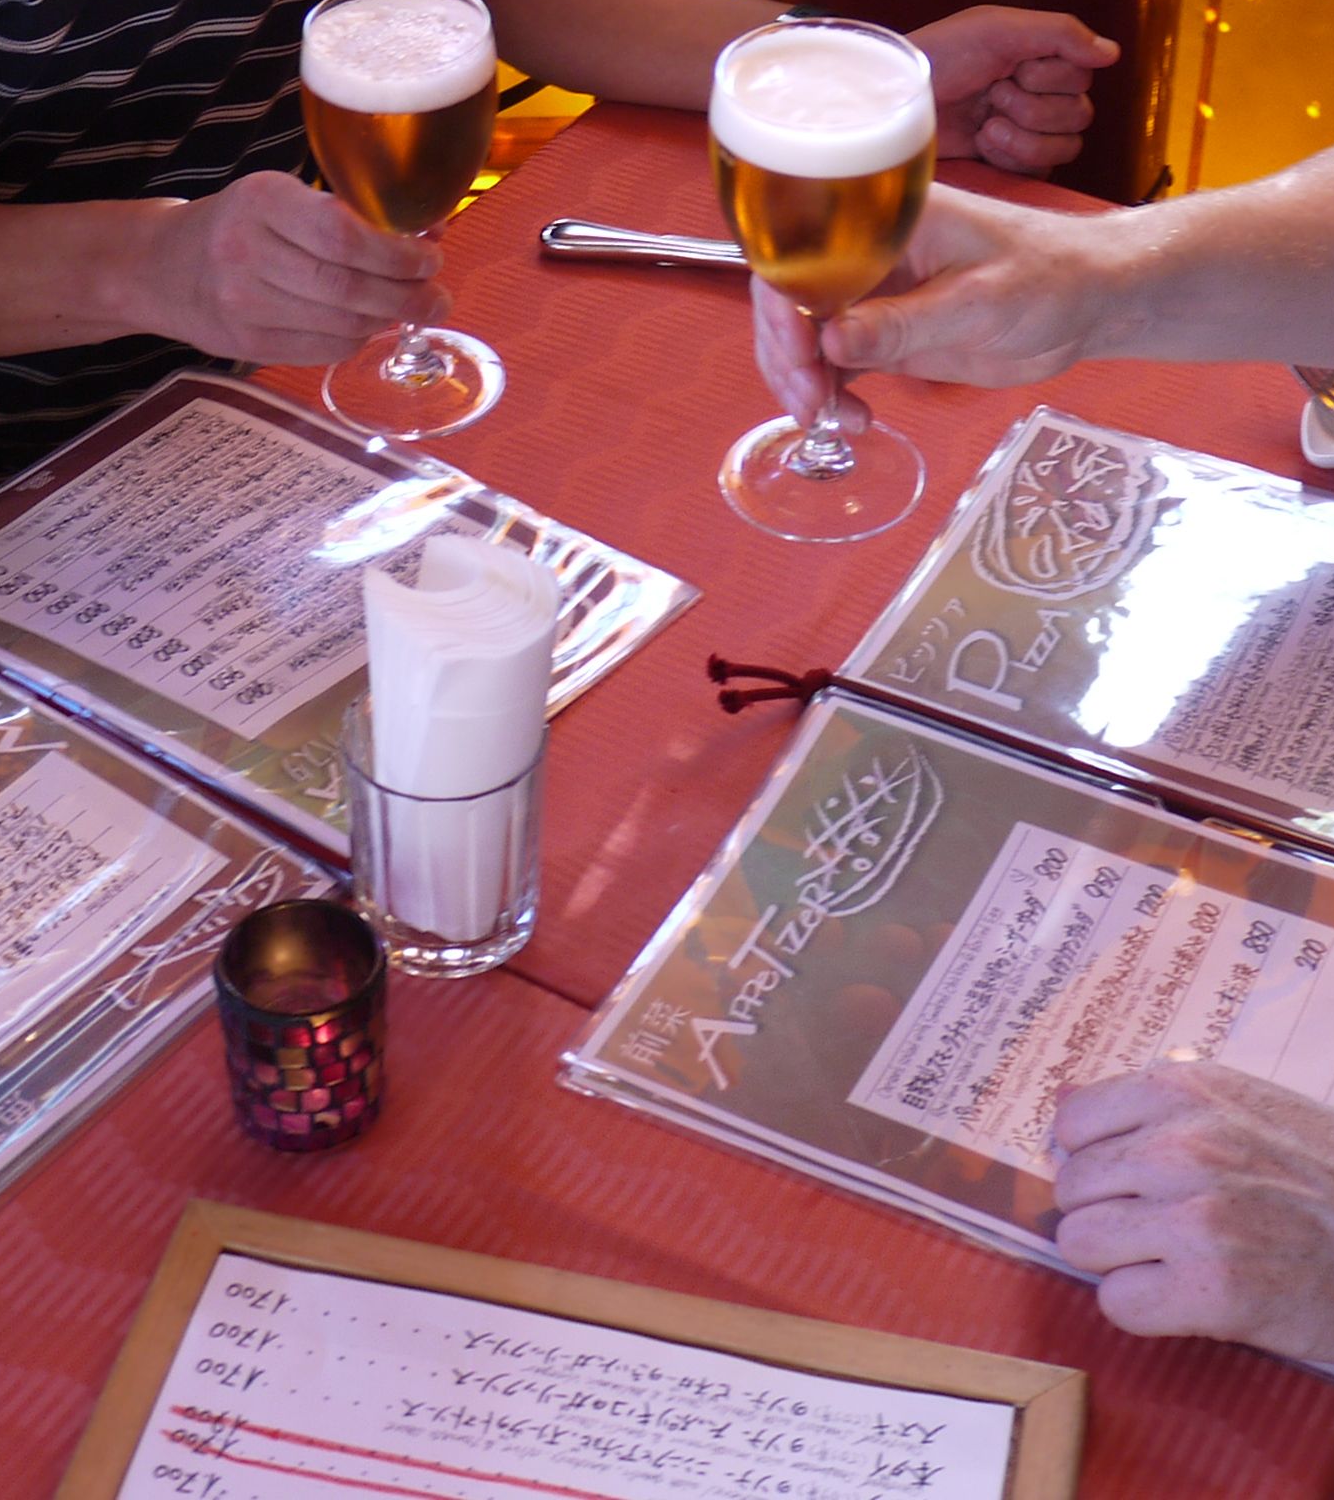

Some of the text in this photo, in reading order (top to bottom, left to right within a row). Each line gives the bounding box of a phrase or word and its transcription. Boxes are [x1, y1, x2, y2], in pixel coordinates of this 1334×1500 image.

[1033, 846, 1068, 880] 800
[1083, 865, 1122, 899] 950
[1188, 901, 1221, 934] 800
[1241, 919, 1276, 954] 850
[1294, 938, 1327, 971] 200
[619, 998, 691, 1068] 前菜
[224, 1281, 290, 1316] 1700
[208, 1320, 277, 1353] 1700
[194, 1357, 263, 1391] 1700
[743, 1390, 807, 1416] のソテー
[742, 1428, 804, 1453] のソテー
[872, 1417, 946, 1445] スズキ
[150, 1462, 222, 1498] 1700
[725, 1469, 791, 1494] のソテー
[869, 1454, 943, 1487] 本タイ
